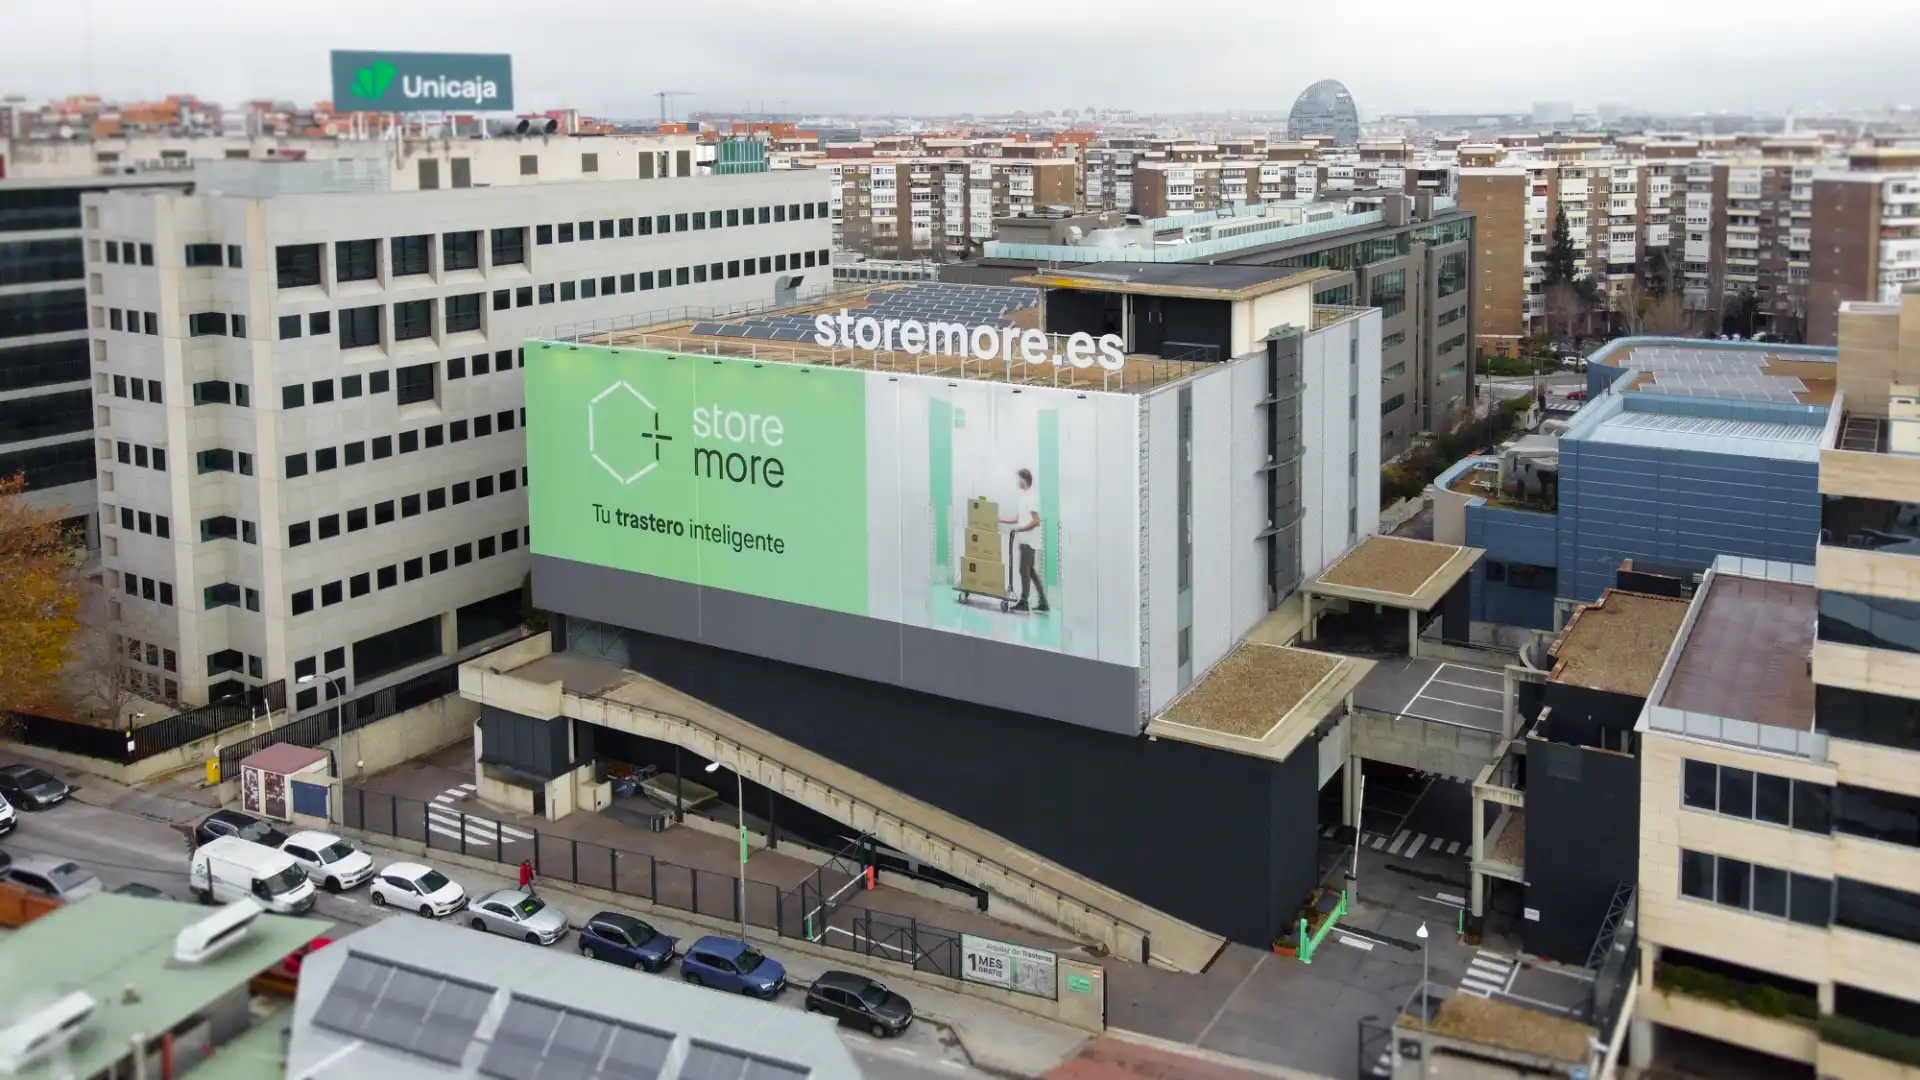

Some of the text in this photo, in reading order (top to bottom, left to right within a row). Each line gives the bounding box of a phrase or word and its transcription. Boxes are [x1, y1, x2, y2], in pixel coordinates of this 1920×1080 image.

[402, 75, 497, 105] Unicaja
[813, 307, 1126, 371] storemore.es
[692, 402, 784, 447] store
[694, 446, 785, 489] more
[592, 503, 785, 554] Tu trastero inteligente
[967, 953, 1003, 972] 1 MES
